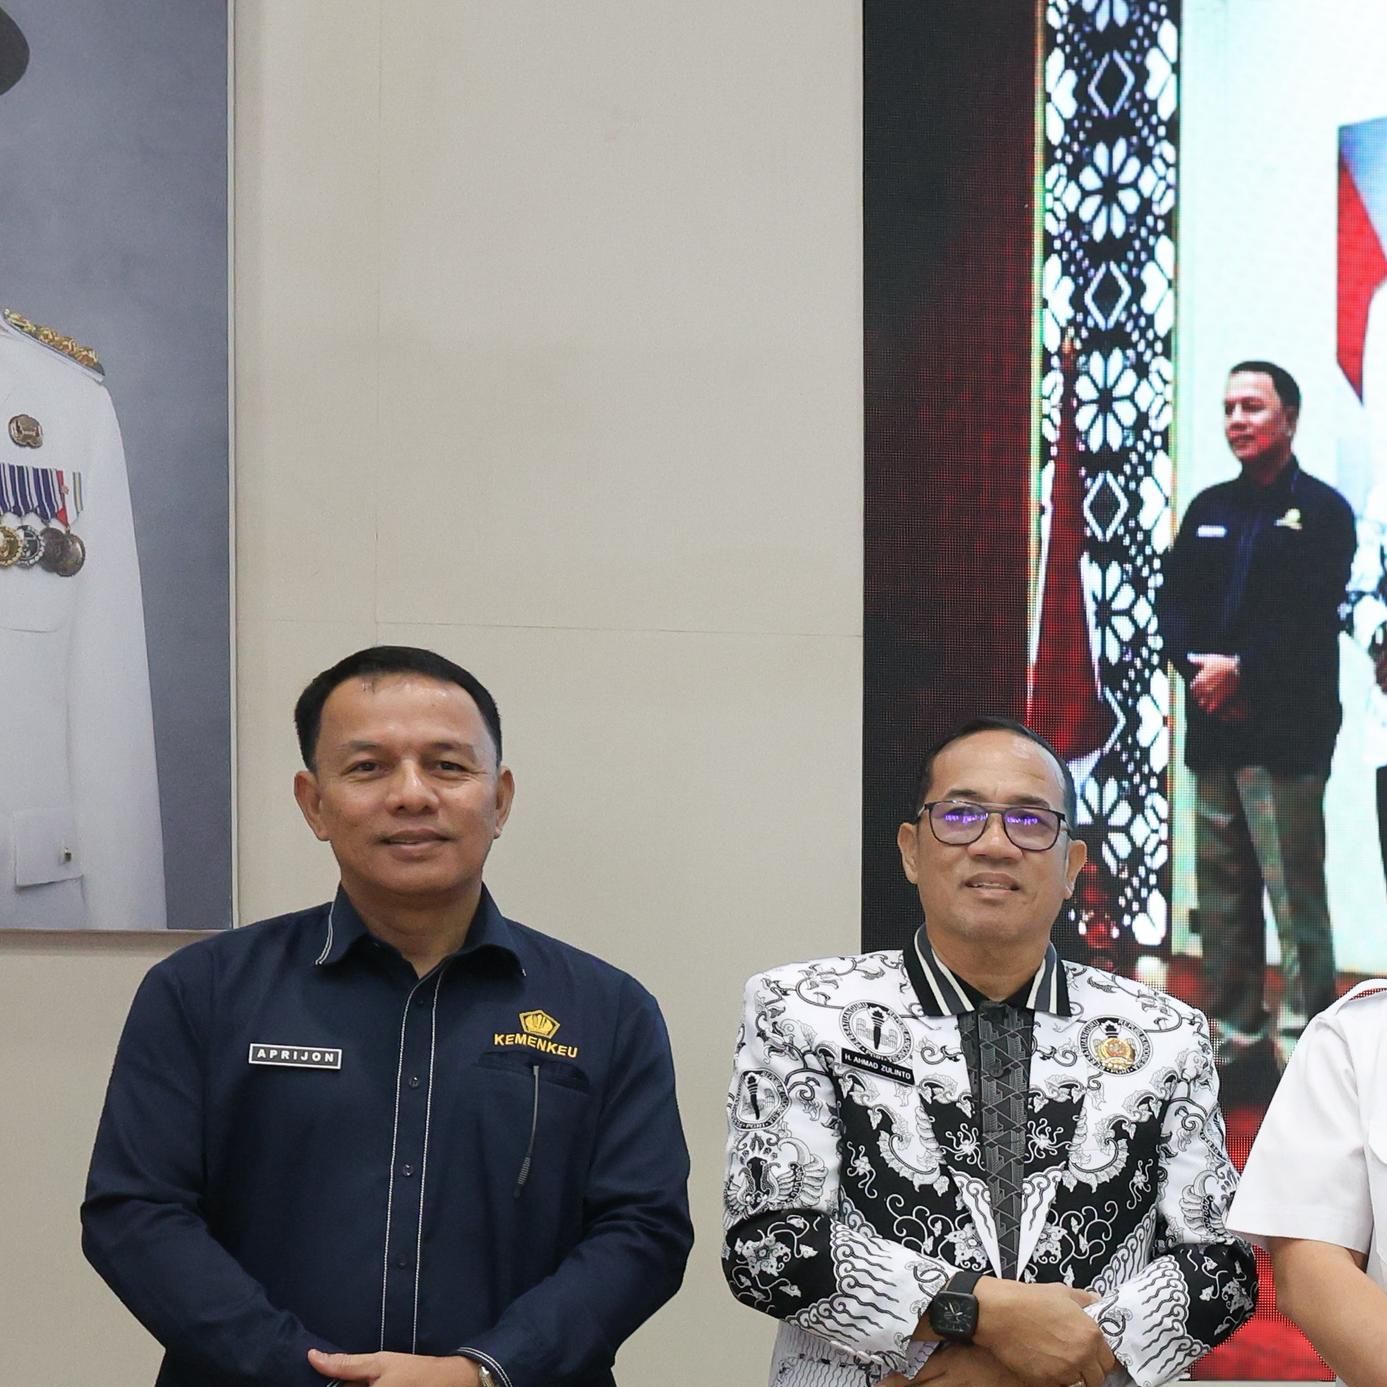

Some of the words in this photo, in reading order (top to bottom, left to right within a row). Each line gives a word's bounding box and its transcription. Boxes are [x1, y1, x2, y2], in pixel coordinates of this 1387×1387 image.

[256, 1048, 335, 1063] APRIJON
[493, 1032, 579, 1059] KEMENKEU
[844, 1053, 852, 1062] H.
[853, 1056, 879, 1070] AHMAD
[880, 1065, 911, 1080] ZULINTO
